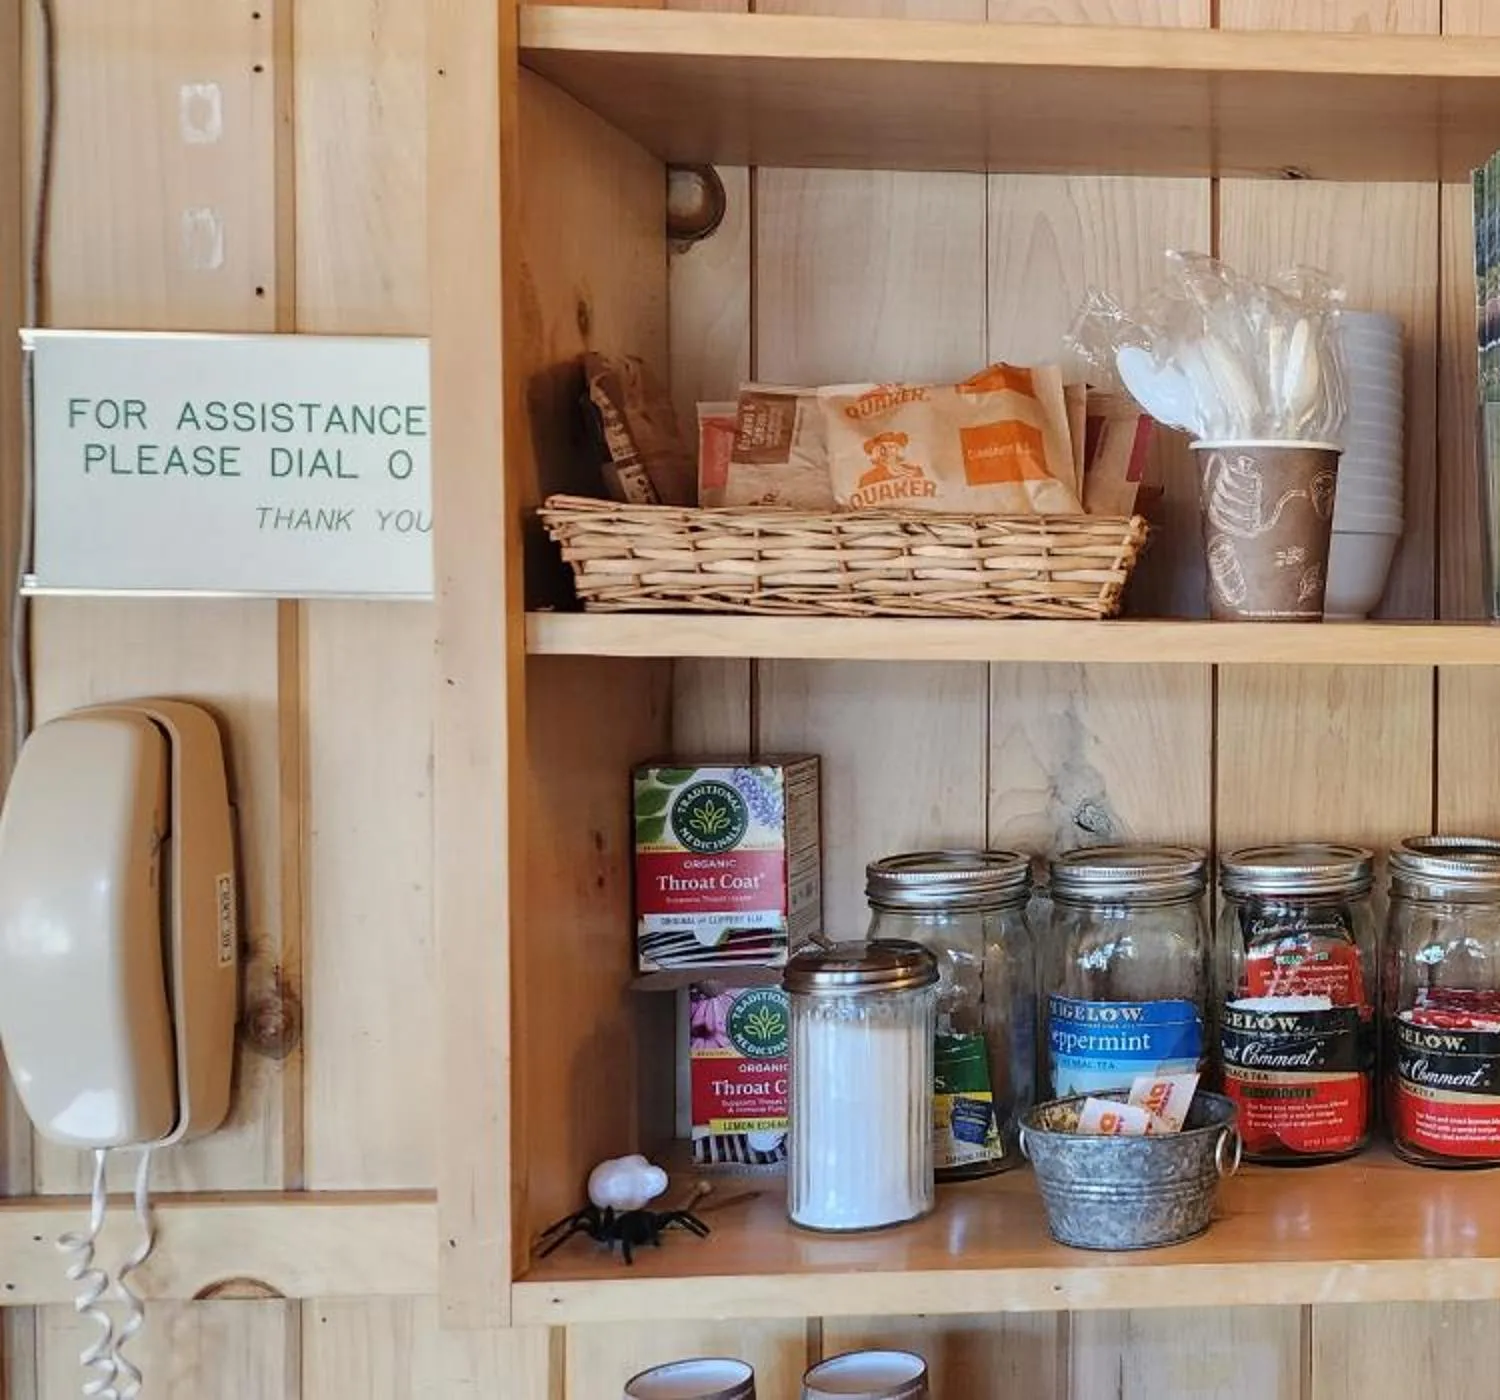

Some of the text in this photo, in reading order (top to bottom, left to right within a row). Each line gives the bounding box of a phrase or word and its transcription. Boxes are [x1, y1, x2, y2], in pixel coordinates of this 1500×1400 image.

[845, 386, 925, 420] QUAKER
[68, 399, 428, 436] FOR ASSISTANCE
[84, 444, 241, 477] PLEASE
[271, 447, 359, 479] DIAL
[849, 478, 938, 511] QUAKER
[256, 507, 432, 533] THANK YOU
[678, 785, 741, 813] TRADITIONAL
[680, 822, 744, 850] MEDICINALS
[683, 859, 737, 869] ORGANIC
[656, 874, 716, 891] Throat
[732, 991, 788, 1020] TRADITION
[1051, 1030, 1151, 1053] eppermint
[711, 1080, 770, 1096] Throat
[723, 1121, 754, 1131] LEMON
